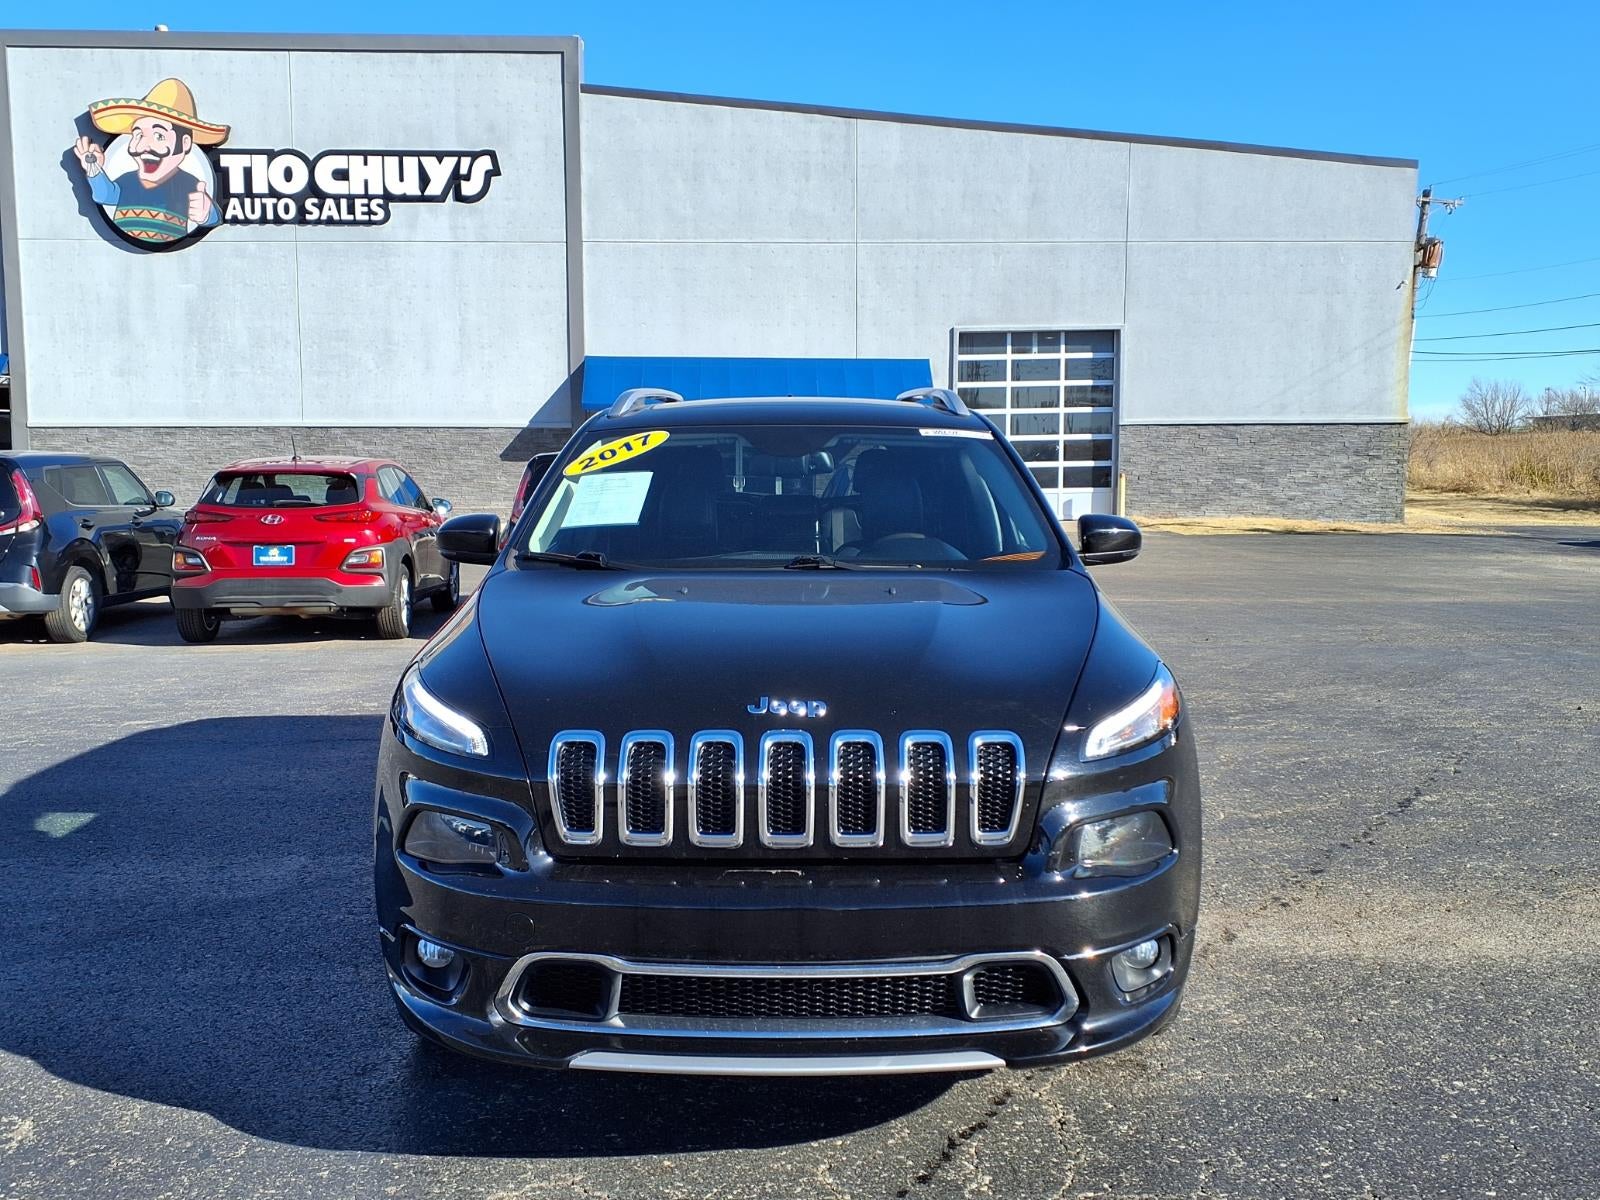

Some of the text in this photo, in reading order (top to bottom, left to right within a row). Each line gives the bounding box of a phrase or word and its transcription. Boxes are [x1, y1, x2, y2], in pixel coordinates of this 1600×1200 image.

[219, 153, 494, 197] TIO CHUY'S
[224, 197, 386, 222] AUTO SALES
[578, 433, 651, 471] 2017
[747, 696, 827, 718] Jeep
